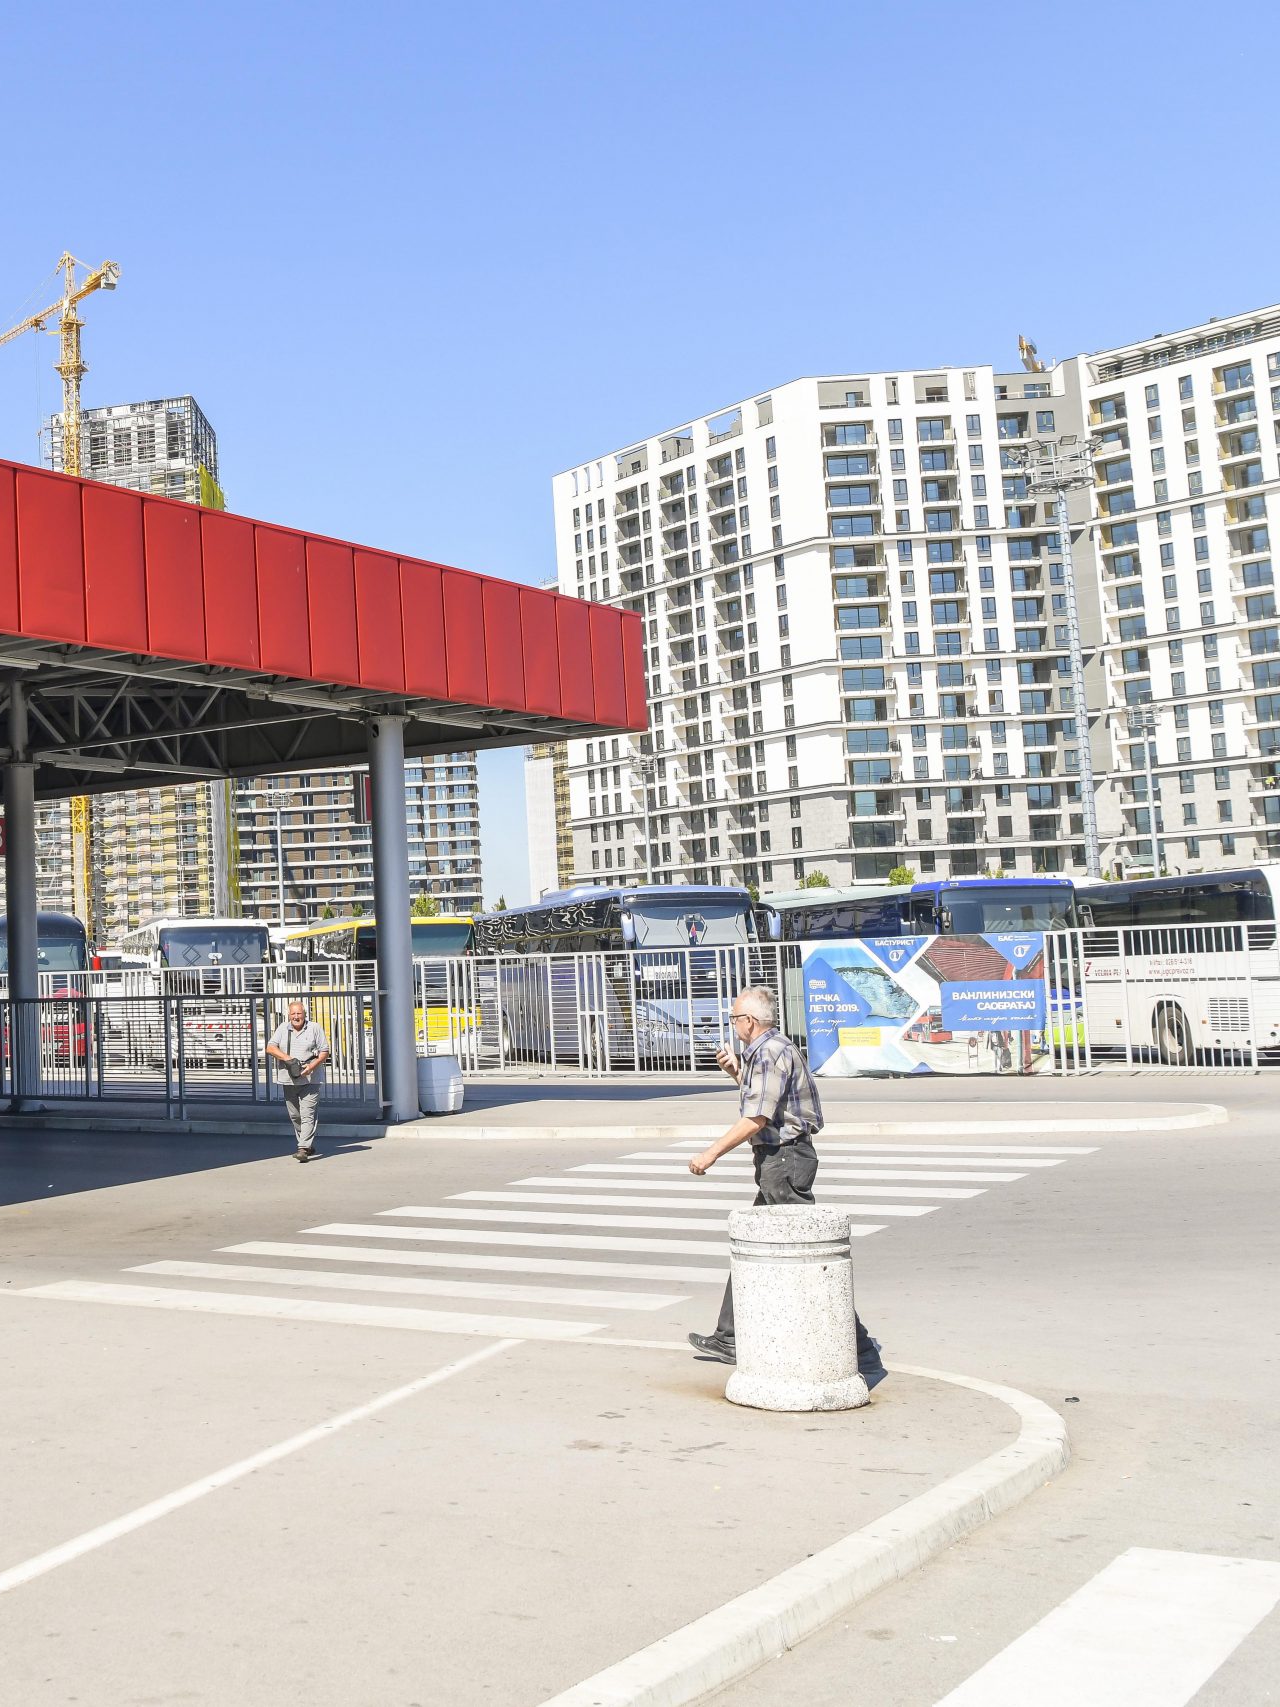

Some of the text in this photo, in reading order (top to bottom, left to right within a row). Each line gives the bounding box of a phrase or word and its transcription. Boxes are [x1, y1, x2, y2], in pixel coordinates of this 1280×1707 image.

[809, 994, 840, 1002] ГРЧКА
[952, 990, 1035, 1000] ВАНЛИНИЈСКИ
[809, 1004, 860, 1012] ЛЕТО 2019.
[977, 1001, 1036, 1010] САОБРАЋАЈ
